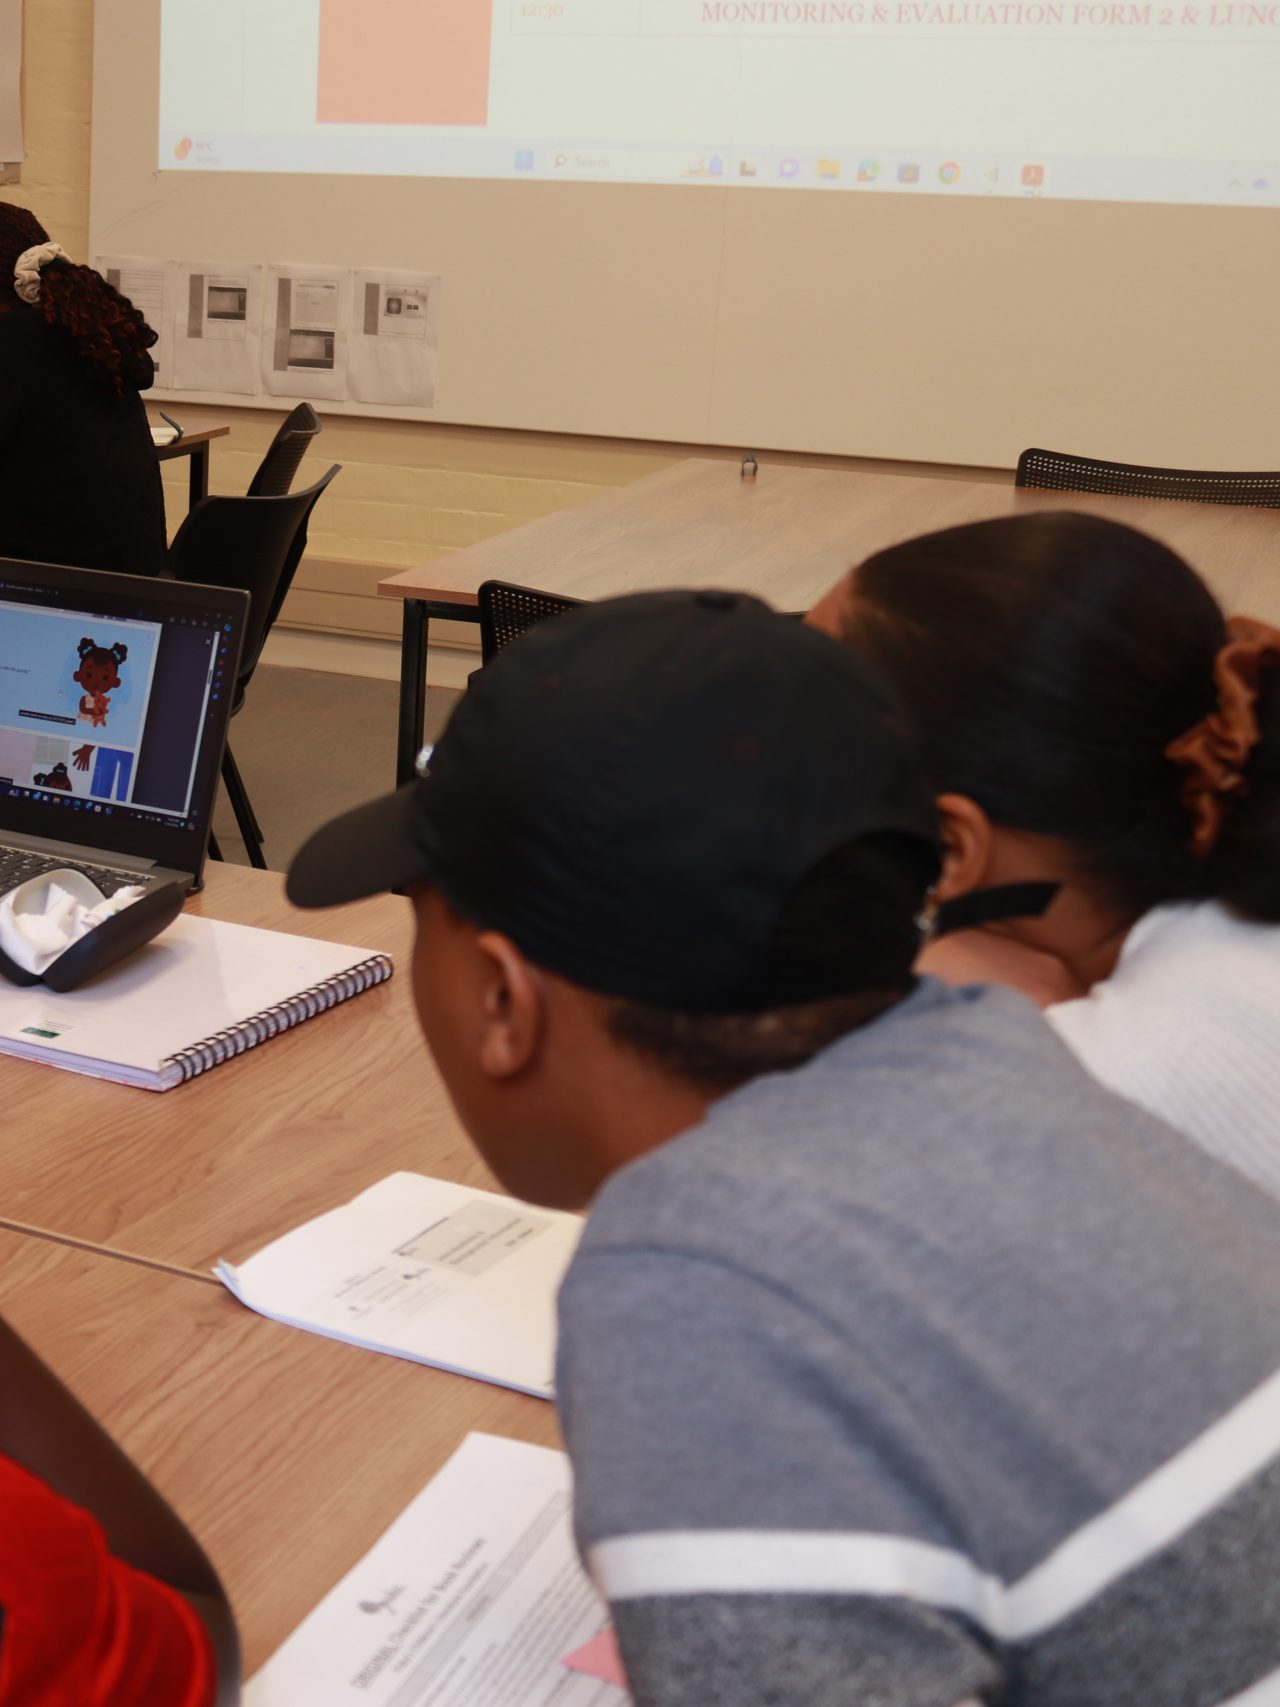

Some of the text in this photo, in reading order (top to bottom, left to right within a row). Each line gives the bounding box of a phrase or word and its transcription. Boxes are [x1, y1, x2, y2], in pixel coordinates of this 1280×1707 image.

[519, 3, 564, 19] 12:30
[701, 2, 1280, 27] MONITORING & EVALUATION FORM 2 & LUNC
[575, 154, 610, 170] Search
[348, 1642, 398, 1690] ORIGINAL
